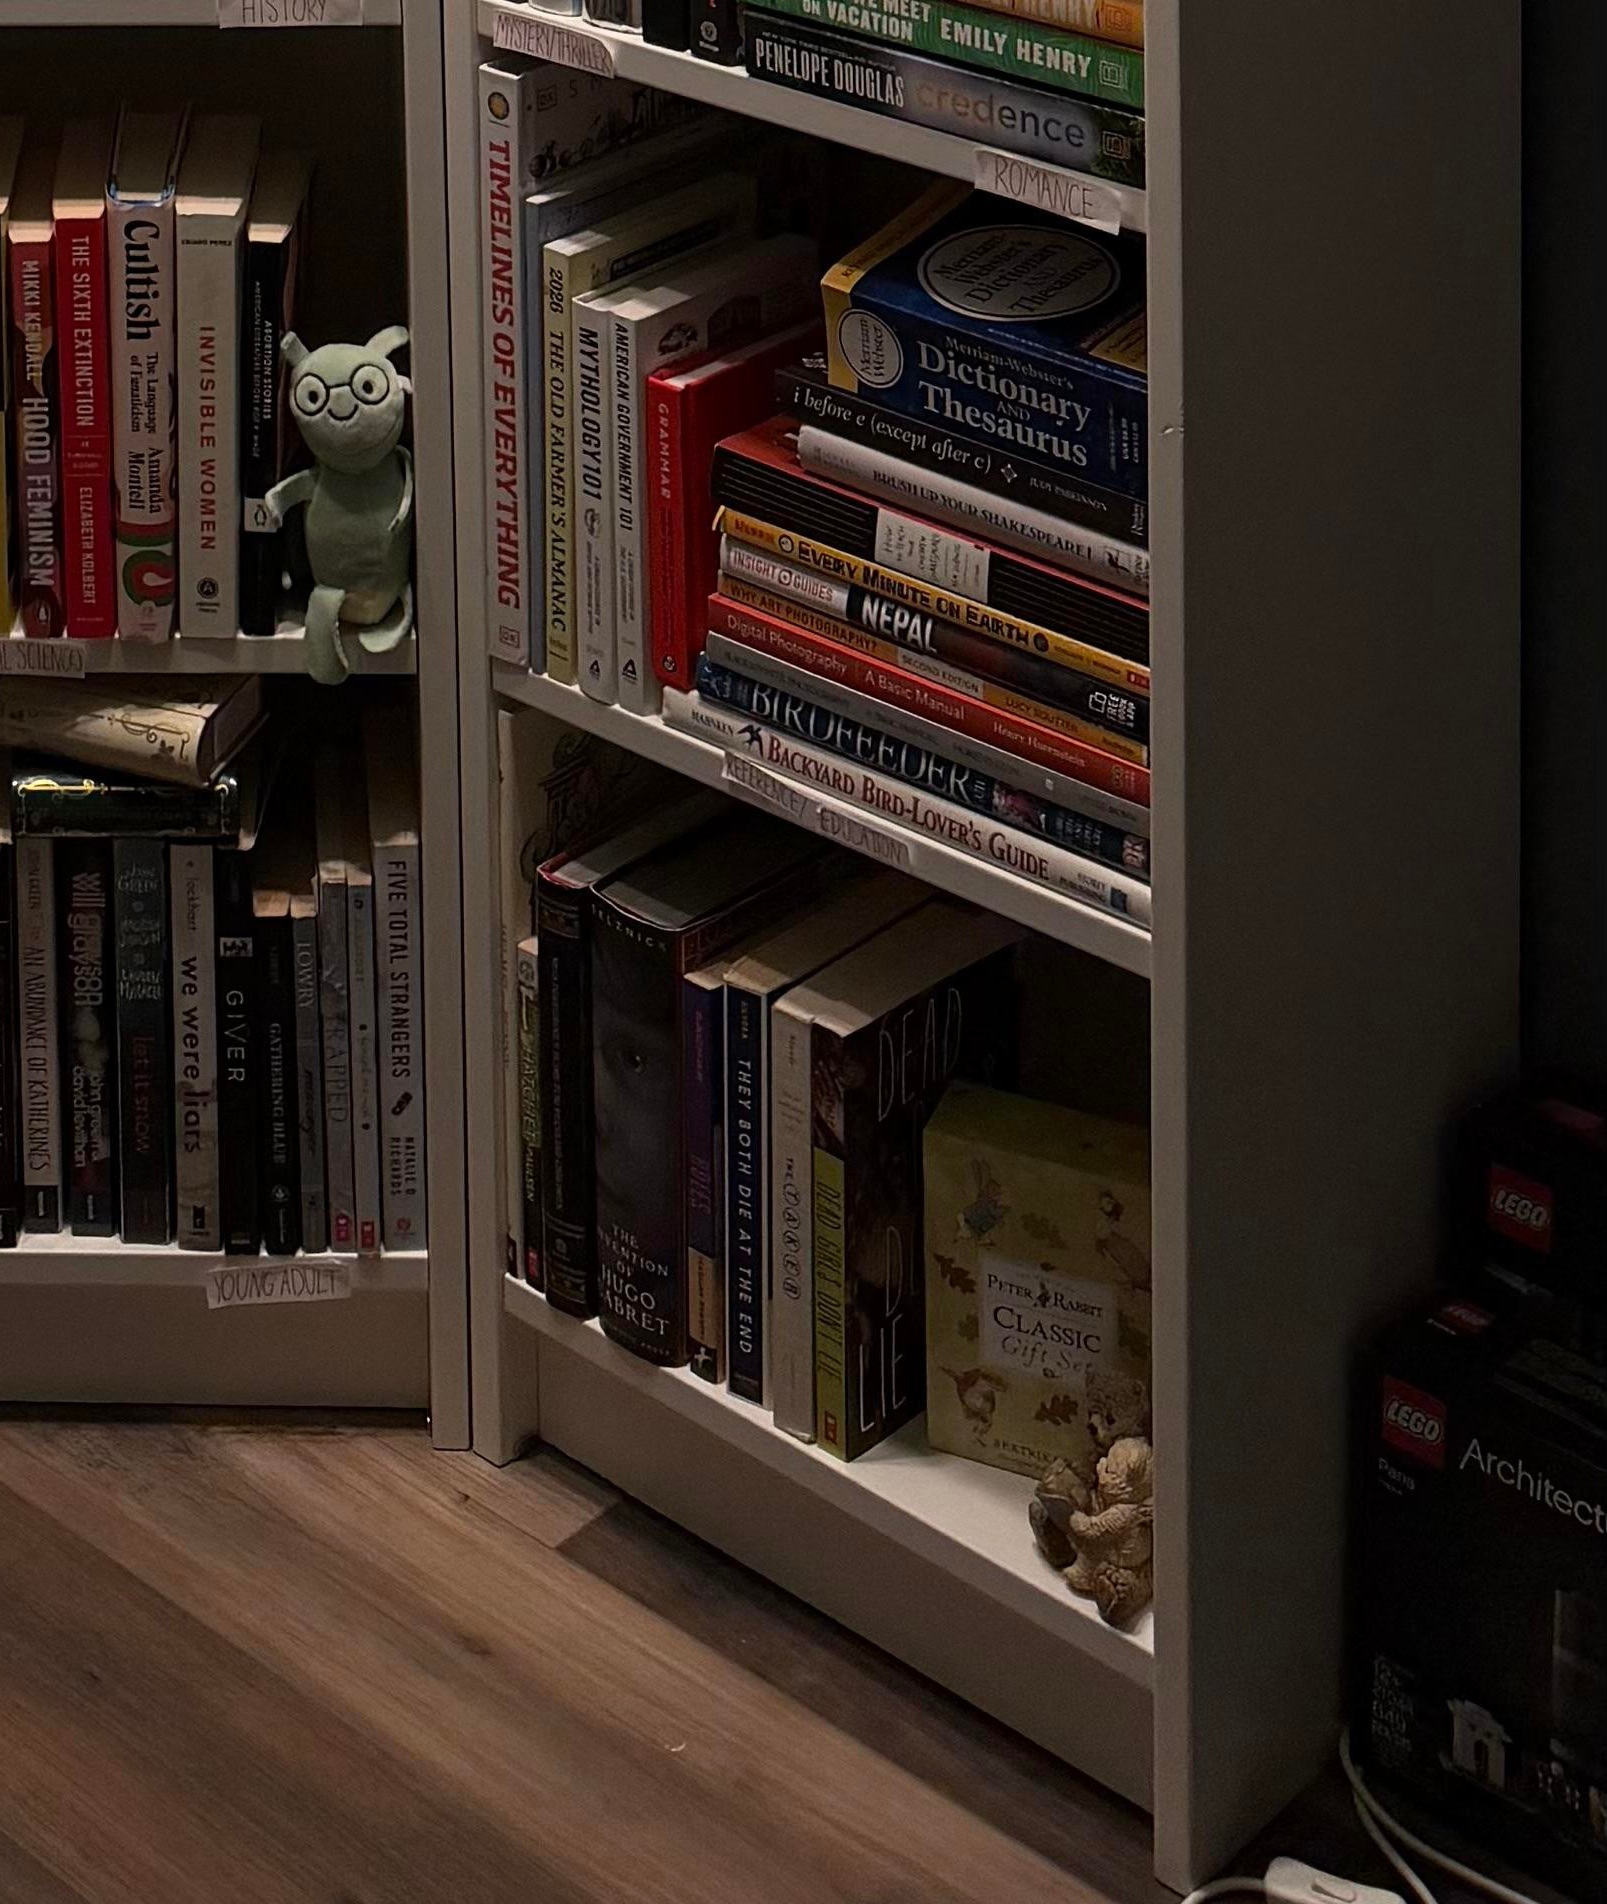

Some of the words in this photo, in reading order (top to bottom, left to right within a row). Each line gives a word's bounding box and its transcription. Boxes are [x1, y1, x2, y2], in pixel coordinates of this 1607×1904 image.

[918, 84, 1084, 147] credence
[995, 166, 1095, 216] ROMANCE
[125, 221, 159, 342] Cultish
[198, 326, 215, 448] INVISIBLE
[915, 340, 1091, 429] Dictionary
[918, 381, 1089, 468] Thesaurus
[200, 457, 215, 552] WOMEN
[860, 594, 938, 655] NEPAL
[388, 860, 405, 902] FIVE
[389, 908, 408, 965] TOTAL
[224, 989, 246, 1082] GIVER
[390, 971, 411, 1078] STRANGERS
[1493, 1188, 1549, 1228] LEGO
[992, 1305, 1102, 1354] CLASSIC
[1386, 1397, 1442, 1443] LEGO
